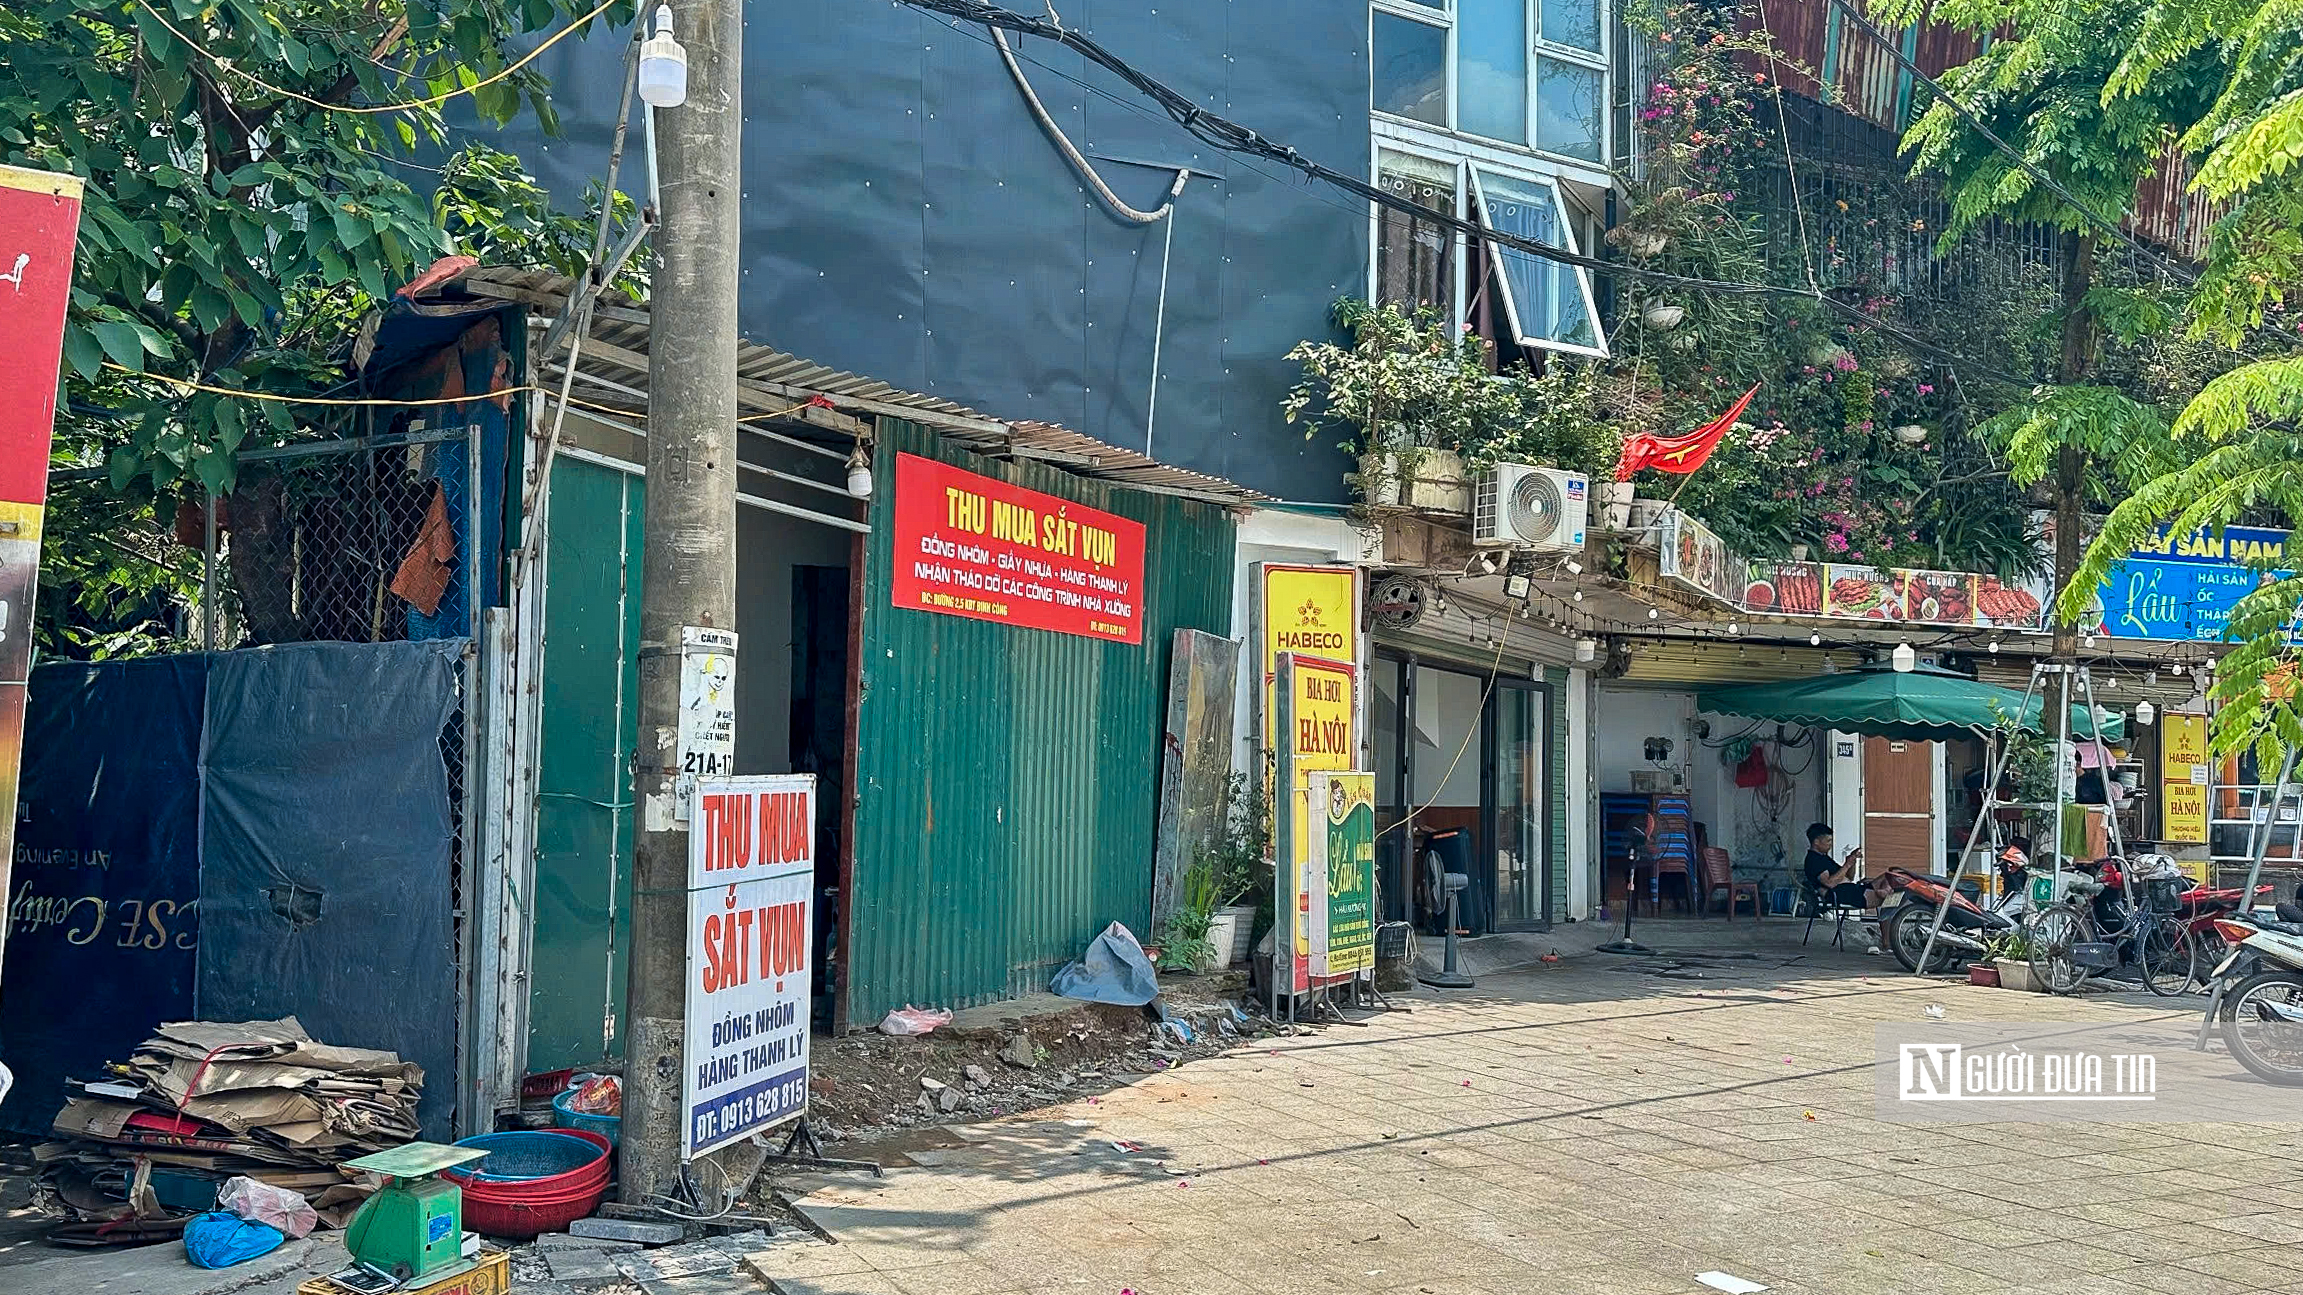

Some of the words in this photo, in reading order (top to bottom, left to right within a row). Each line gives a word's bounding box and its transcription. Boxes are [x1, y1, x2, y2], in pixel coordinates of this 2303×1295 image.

[946, 486, 986, 535] THU
[992, 499, 1037, 548] MUA
[1042, 505, 1077, 557] SẮT
[1082, 524, 1116, 571] VỤN
[2176, 530, 2224, 559] SẢN
[921, 532, 956, 559] ĐỒNG
[957, 544, 990, 566] NHÔM
[1060, 566, 1086, 586] HÀNG
[1087, 573, 1118, 594] THANH
[1118, 579, 1129, 596] LÝ
[2197, 569, 2220, 585] HẢI
[2222, 570, 2248, 587] SẢN
[914, 561, 951, 586] NHẬN
[953, 568, 983, 590] THÁO
[1002, 576, 1024, 597] CÁC
[1025, 582, 1053, 603] CÔNG
[1055, 588, 1082, 609] TRÌNH
[1082, 595, 1102, 612] NHÀ
[2120, 567, 2183, 637] Lẩu
[2197, 587, 2215, 603] ỐC
[1277, 631, 1343, 649] HABECO
[1306, 676, 1322, 701] BIA
[1323, 679, 1341, 703] HƠI
[1299, 710, 1321, 753] HÀ
[1322, 713, 1347, 763] NỘI
[2168, 752, 2201, 764] HABECO
[2170, 799, 2185, 816] HÀ
[2185, 799, 2201, 819] NỘI
[2174, 786, 2185, 796] BIA
[702, 793, 752, 871] THU
[758, 792, 810, 866] MUA
[16, 842, 79, 870] Evening
[84, 849, 113, 872] An
[702, 882, 753, 994] SẮT
[758, 901, 806, 993] VỤN
[712, 1010, 752, 1049] ĐỒNG
[755, 1000, 795, 1036] NHÔM
[698, 1054, 738, 1091] HÀNG
[742, 1038, 786, 1075] THANH
[789, 1028, 804, 1059] LÝ
[696, 1109, 717, 1143] ĐT:
[720, 1096, 753, 1133] 0913
[755, 1086, 779, 1120] 628
[781, 1077, 804, 1108] 815
